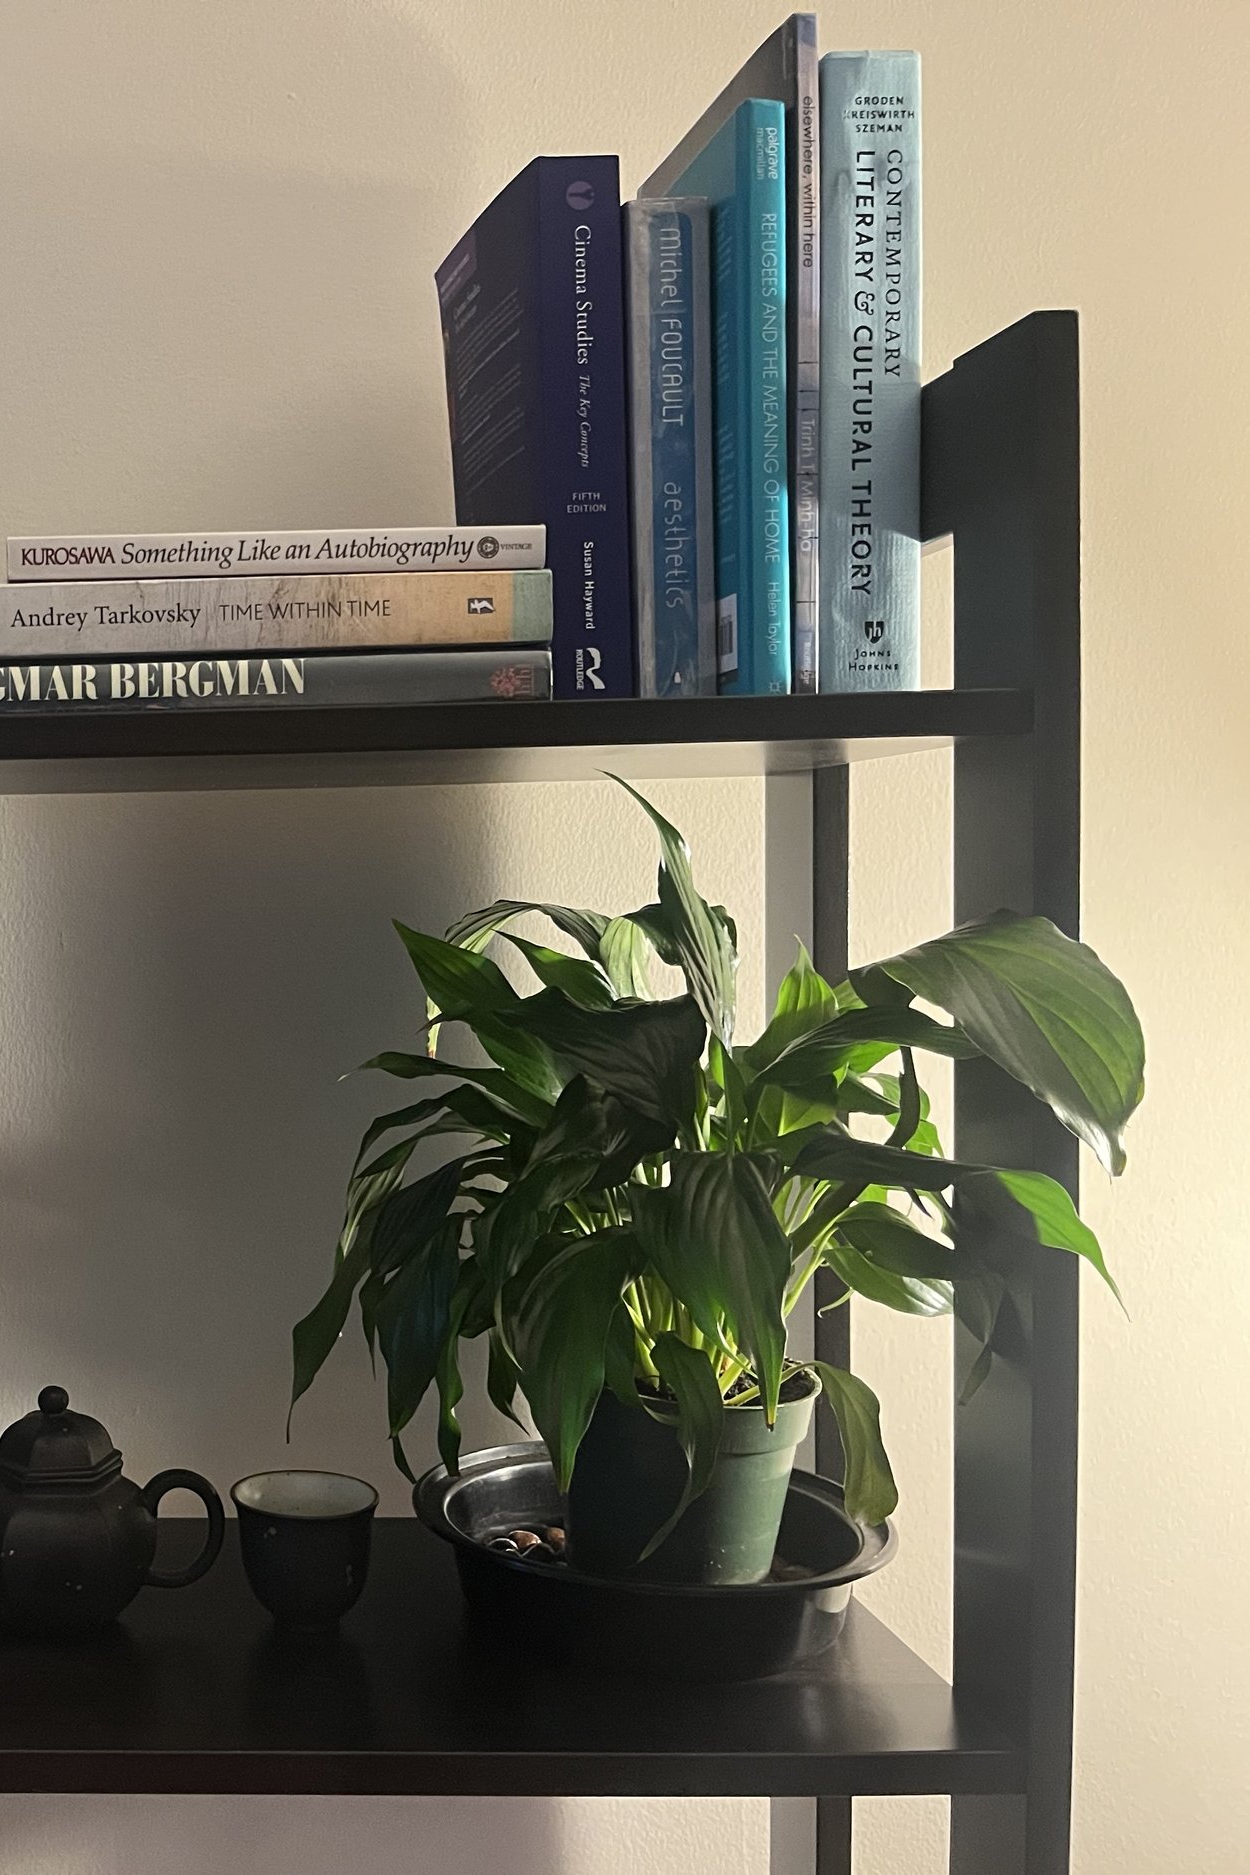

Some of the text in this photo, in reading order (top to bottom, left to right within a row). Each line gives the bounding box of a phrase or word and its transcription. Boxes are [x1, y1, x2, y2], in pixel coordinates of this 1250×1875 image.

[855, 96, 904, 105] GRODEN
[756, 127, 766, 180] macmillan
[765, 127, 779, 180] palgrave
[855, 124, 903, 133] SZEMAN
[802, 96, 815, 268] elsewhere, within here
[884, 149, 903, 377] CONTEMPORARY
[574, 224, 594, 468] Cinema Studies The Key Concepts
[661, 318, 684, 427] FOUCAULT
[851, 150, 876, 595] LITERARY & CULTURAL THEORY
[761, 213, 781, 563] REFUGEES AND THE MEANING OF HOME
[802, 418, 815, 458] Trinh
[567, 504, 607, 513] EDITION
[572, 492, 600, 501] FIFTH
[21, 534, 474, 569] KUROSAWA Something Like an Autobiography
[664, 481, 691, 609] aesthetics
[584, 541, 596, 630] Susan Hayward
[10, 599, 392, 632] Andrey Tarkovsky TIME WITHIN TIME
[766, 582, 782, 656] Helen Taylor
[110, 657, 307, 699] BERGMAN
[576, 649, 585, 690] ROUTLEDGE
